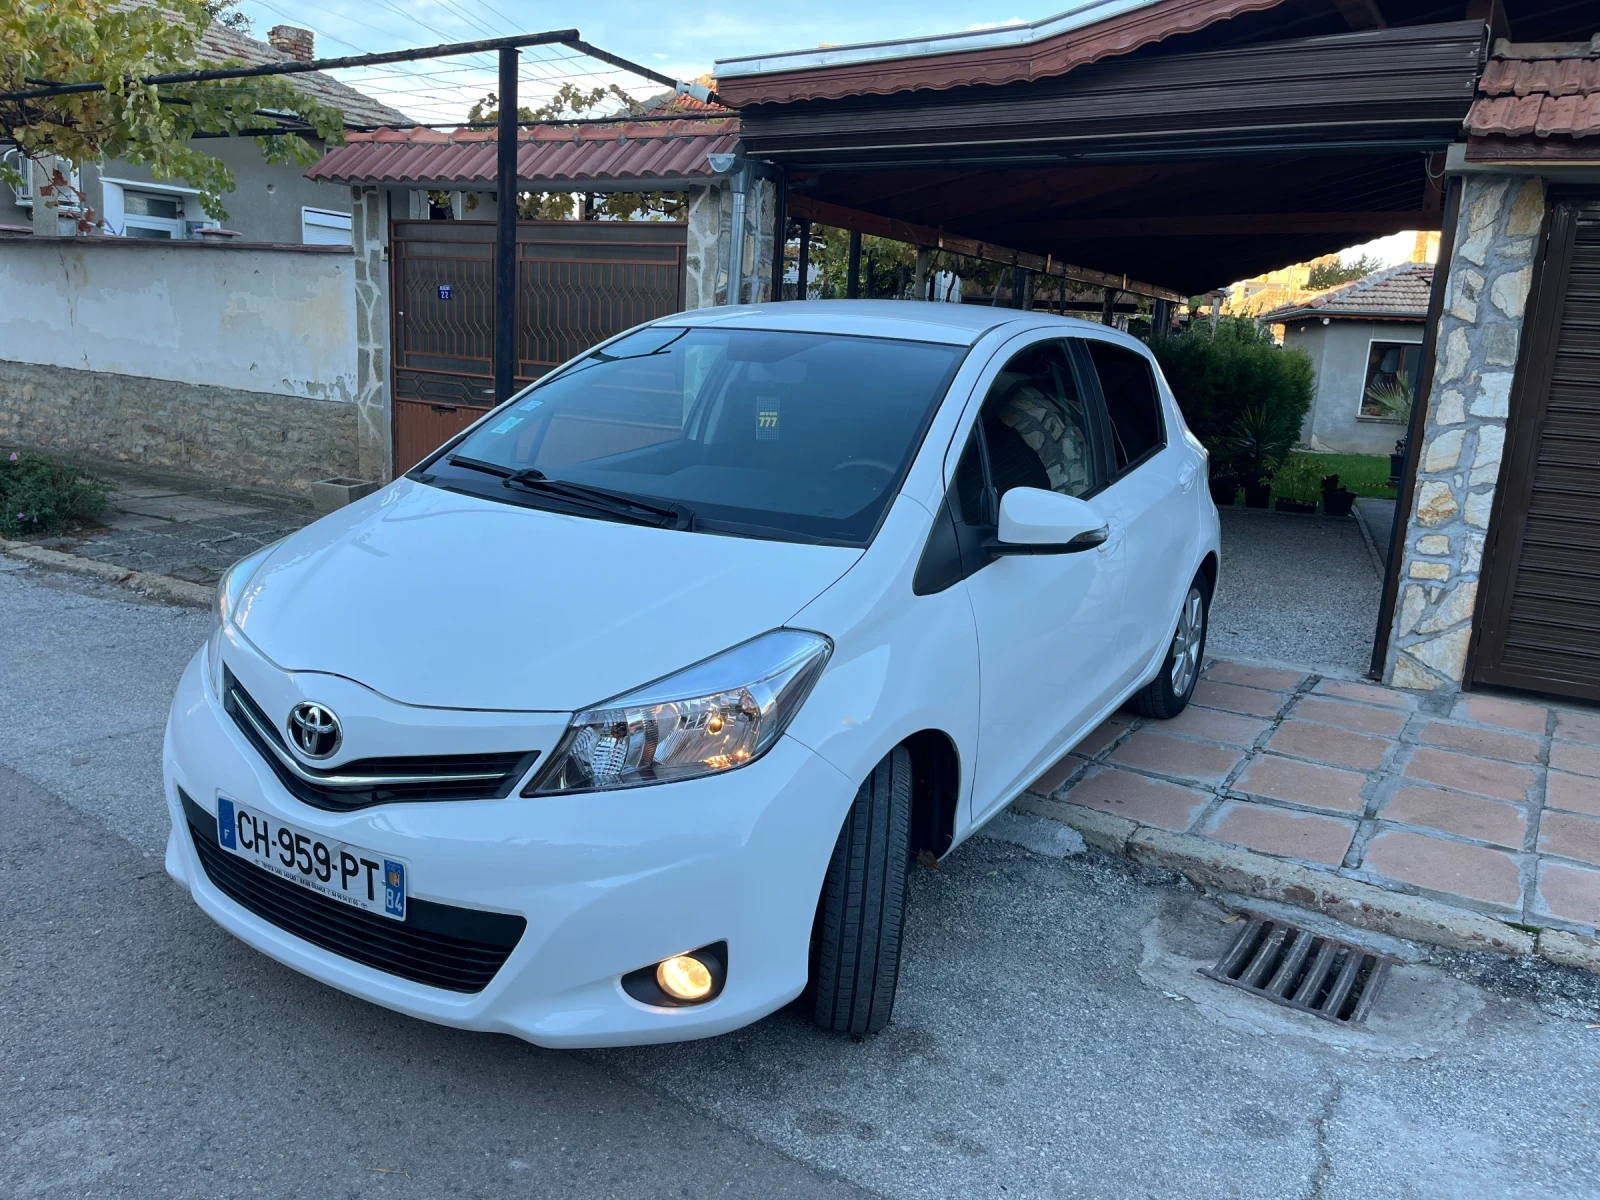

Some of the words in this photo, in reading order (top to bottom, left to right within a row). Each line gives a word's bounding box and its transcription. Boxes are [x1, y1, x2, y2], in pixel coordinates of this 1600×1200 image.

[440, 290, 449, 299] 22
[759, 416, 778, 428] 777
[224, 828, 230, 840] F
[237, 810, 380, 901] CH-959-PT
[386, 888, 403, 912] 84
